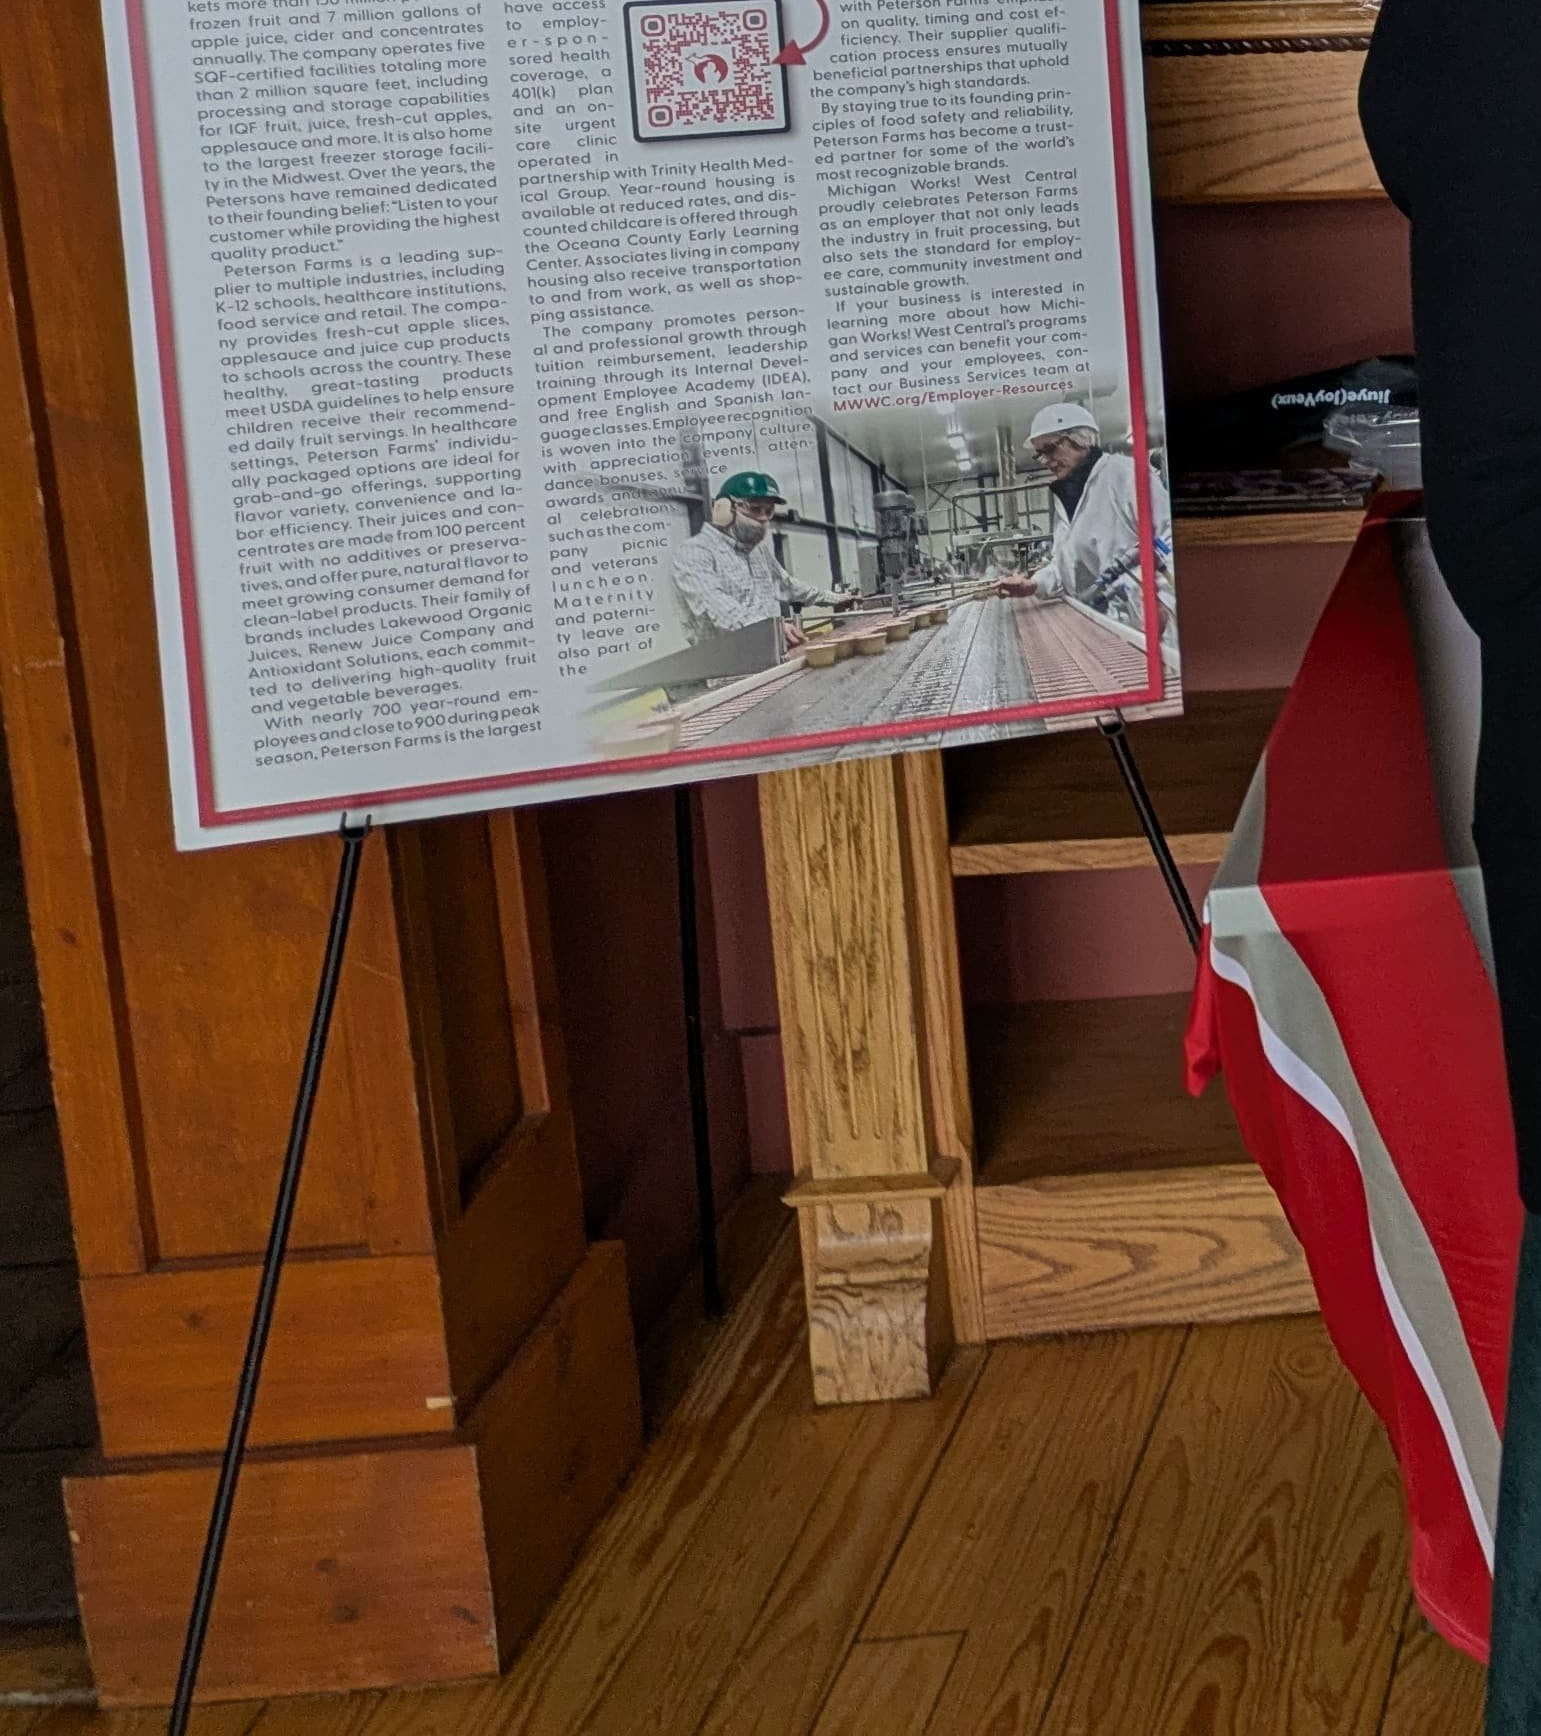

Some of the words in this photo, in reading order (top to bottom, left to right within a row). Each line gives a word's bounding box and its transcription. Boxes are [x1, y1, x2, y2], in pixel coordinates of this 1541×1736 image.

[189, 17, 240, 30] frozen
[248, 14, 280, 26] fruit
[288, 11, 320, 25] and
[327, 10, 335, 22] 7
[343, 9, 394, 21] million
[401, 5, 458, 21] gallons
[466, 2, 481, 15] of
[193, 65, 304, 84] SQF-certified
[309, 63, 375, 77] facilities
[380, 58, 441, 72] totaling
[447, 58, 486, 68] more
[511, 85, 555, 99] 401(k)
[578, 83, 613, 98] plan
[199, 124, 221, 136] for
[228, 121, 256, 134] IQF
[264, 120, 301, 132] fruit,
[308, 118, 349, 133] juice,
[355, 111, 427, 126] fresh-cut
[434, 108, 492, 123] apples,
[518, 168, 610, 188] partnership
[613, 165, 646, 178] with
[650, 162, 696, 175] Trinity
[700, 158, 749, 172] Health
[753, 155, 792, 168] Med-
[827, 182, 896, 197] Michigan
[910, 175, 960, 190] Works!
[974, 173, 1011, 185] West
[1024, 167, 1076, 182] Central
[524, 241, 549, 254] the
[556, 238, 620, 251] Oceana
[626, 232, 681, 245] County
[688, 227, 725, 241] Early
[733, 223, 798, 237] Learning
[823, 270, 841, 280] ee
[846, 267, 883, 278] care,
[888, 258, 967, 275] community
[973, 252, 1049, 268] investment
[1054, 247, 1082, 261] and
[215, 299, 248, 313] K-12
[254, 294, 320, 310] schools,
[324, 288, 411, 304] healthcare
[416, 281, 506, 297] institutions,
[534, 359, 584, 372] tuition
[597, 347, 715, 367] reimbursement,
[727, 338, 807, 355] leadership
[223, 385, 287, 400] healthy,
[311, 375, 419, 395] great-tasting
[442, 365, 513, 383] products
[537, 391, 596, 408] opment
[603, 385, 677, 400] Employee
[685, 378, 755, 392] Academy
[762, 370, 810, 387] (IDEA),
[832, 383, 861, 395] tact
[868, 381, 892, 392] our
[899, 375, 960, 389] Business
[967, 368, 1025, 382] Services
[1032, 365, 1068, 376] team
[1075, 361, 1089, 372] at
[538, 409, 569, 423] and
[577, 408, 608, 419] free
[615, 401, 669, 417] English
[676, 397, 706, 410] and
[714, 391, 773, 408] Spanish
[781, 389, 810, 400] lan-
[833, 380, 1072, 411] MWWC.org/Employer-Resources
[244, 628, 302, 644] brands
[307, 620, 374, 637] includes
[380, 608, 462, 629] Lakewood
[467, 602, 532, 619] Organic
[247, 648, 301, 662] Juices,
[308, 640, 362, 654] Renew
[371, 634, 412, 647] Juice
[419, 625, 495, 642] Company
[502, 617, 534, 632] and
